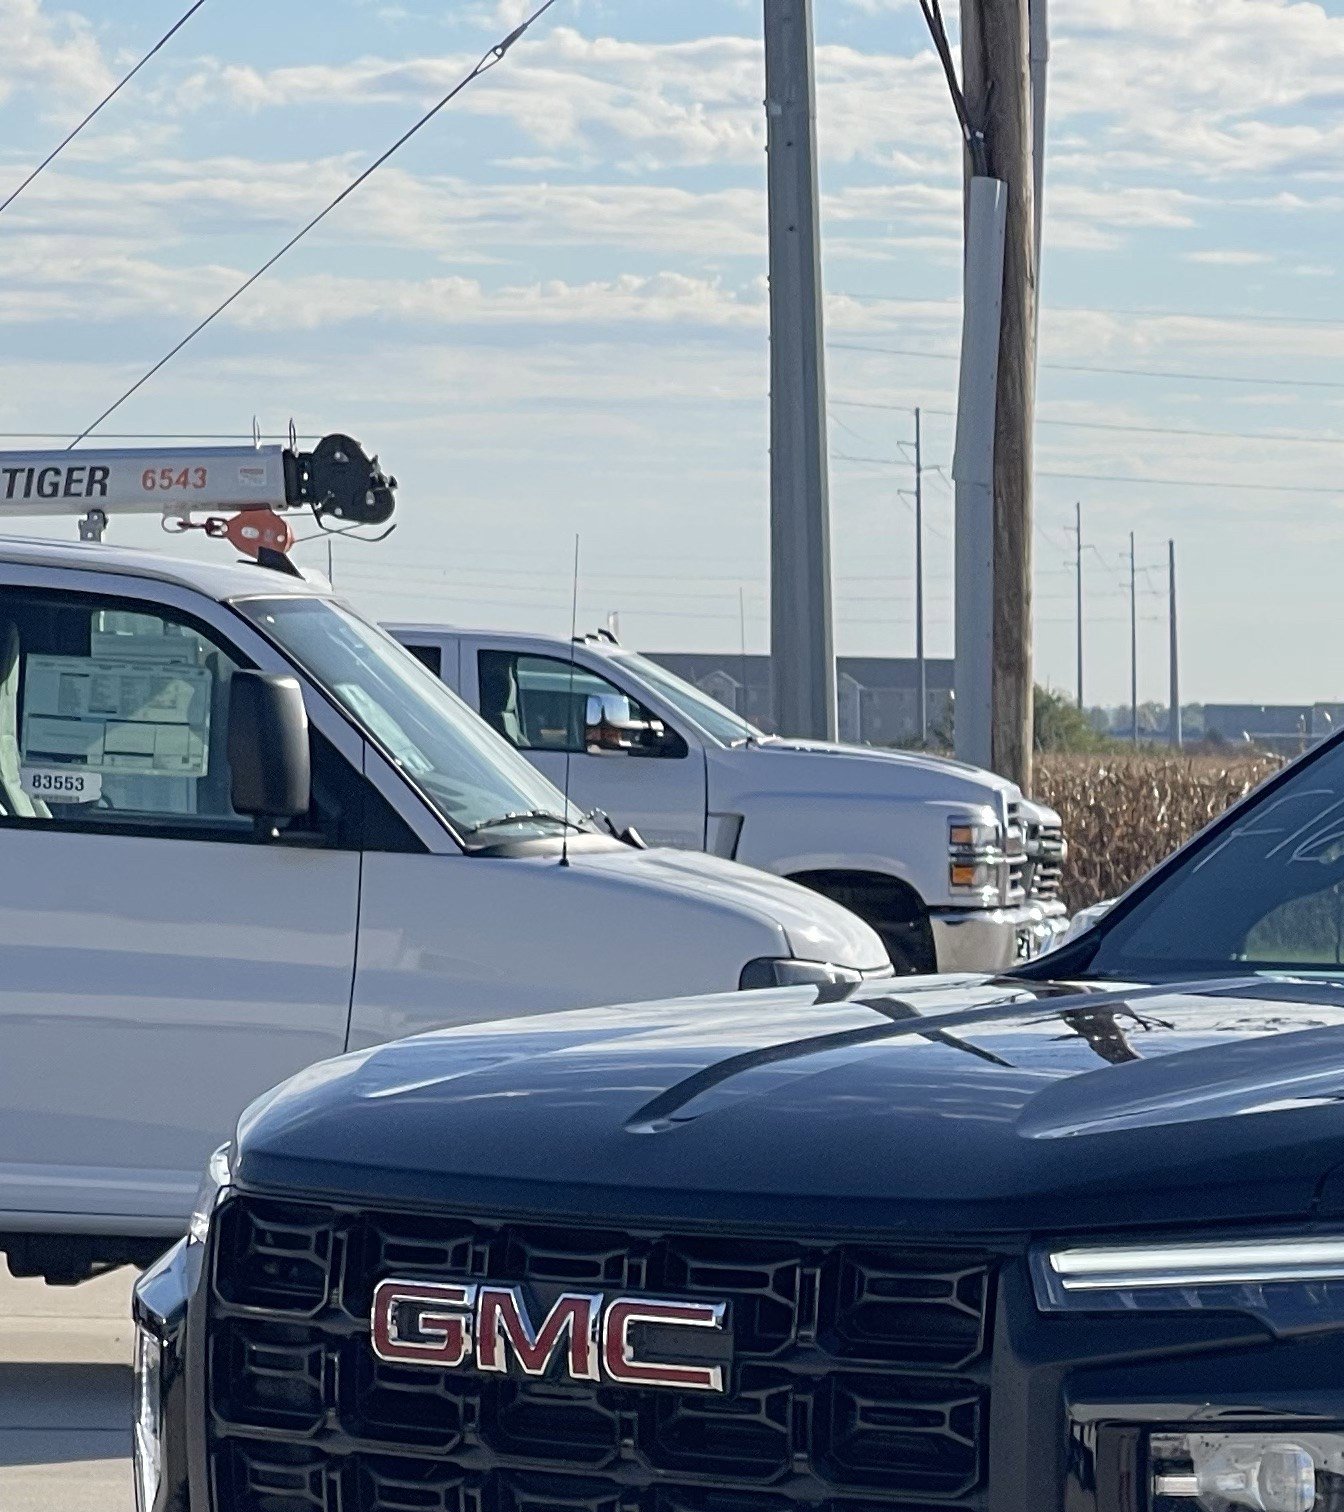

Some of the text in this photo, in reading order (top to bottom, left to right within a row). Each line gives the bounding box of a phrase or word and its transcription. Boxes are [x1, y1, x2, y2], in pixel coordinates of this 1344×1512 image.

[2, 465, 110, 499] TIGER
[142, 467, 207, 491] 6543
[32, 774, 85, 791] 83553
[371, 1278, 725, 1391] GMC
